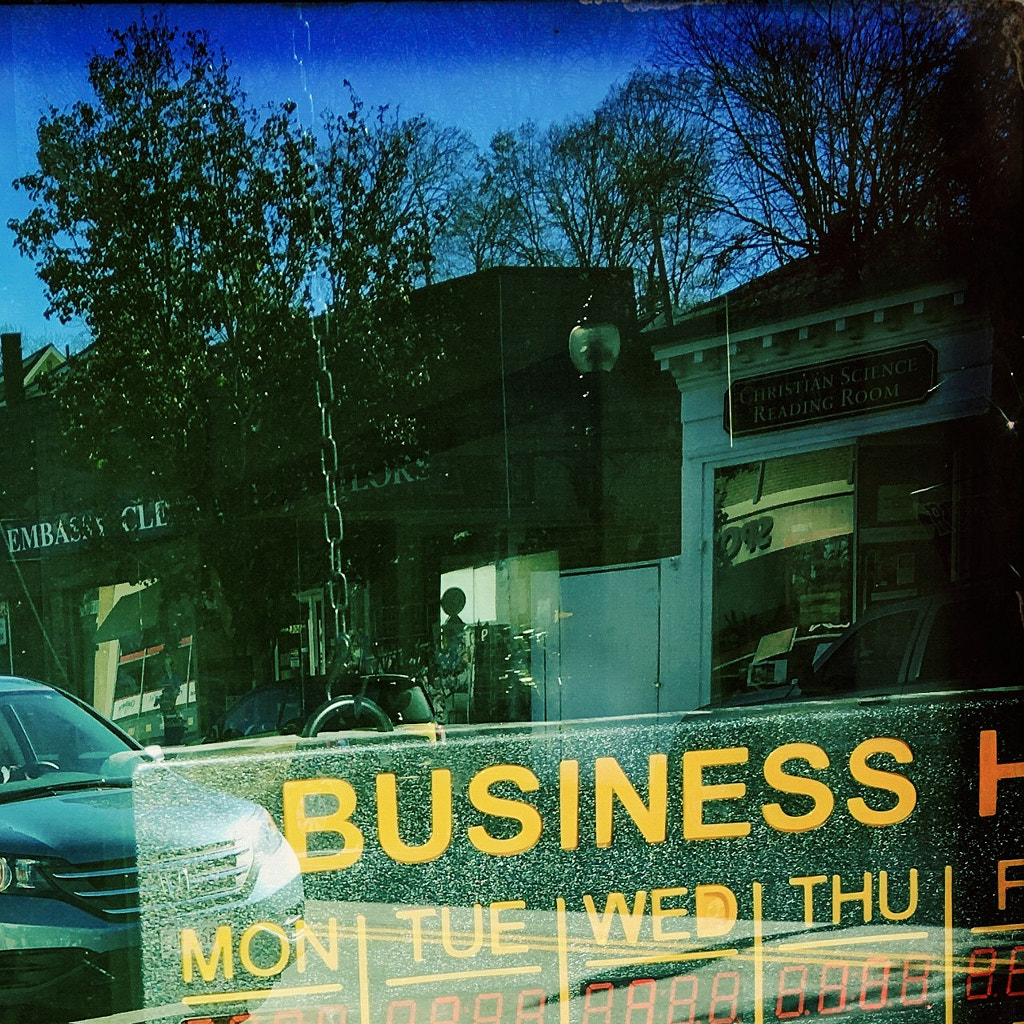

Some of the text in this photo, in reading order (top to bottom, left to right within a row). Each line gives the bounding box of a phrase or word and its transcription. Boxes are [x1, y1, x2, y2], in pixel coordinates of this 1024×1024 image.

[739, 356, 919, 406] CHRISTIAN SCIENCE
[753, 383, 901, 424] READING ROOM
[282, 738, 918, 874] BUSINESS
[583, 883, 739, 945] WED
[788, 868, 919, 926] THU
[182, 917, 340, 984] MON
[395, 899, 529, 962] TUE
